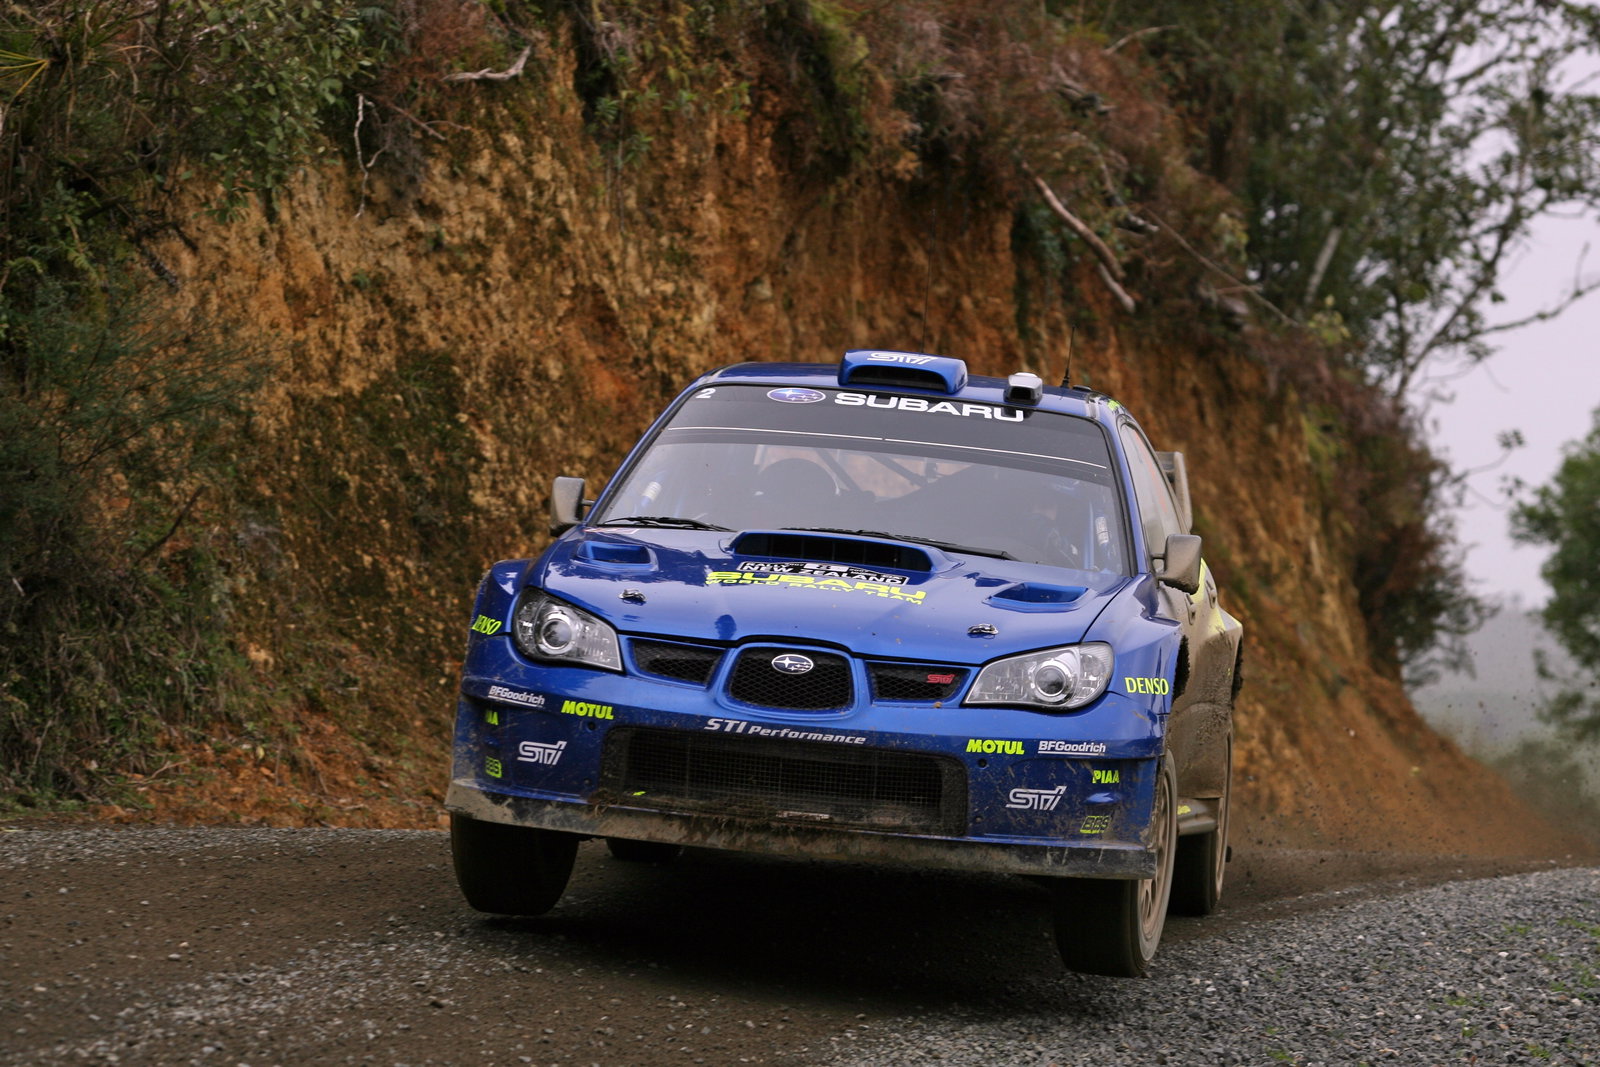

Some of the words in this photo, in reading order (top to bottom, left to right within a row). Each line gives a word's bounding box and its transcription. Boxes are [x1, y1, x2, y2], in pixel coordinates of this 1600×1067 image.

[695, 388, 716, 399] 2
[834, 392, 1024, 422] SUBARU
[743, 565, 794, 573] NEW
[798, 568, 902, 584] ZEALAND
[705, 571, 926, 600] SUBARU
[705, 579, 780, 587] WORLD
[788, 583, 854, 592] RALLY
[864, 590, 922, 605] TEAM
[488, 685, 546, 706] BFGoodrich
[1125, 677, 1169, 695] DENSO
[561, 700, 615, 720] MOTUL
[704, 718, 746, 734] STI
[749, 725, 867, 745] Performance
[966, 739, 1025, 755] MOTUL
[1038, 741, 1106, 753] BFGoodrich
[1092, 769, 1120, 784] PIAA
